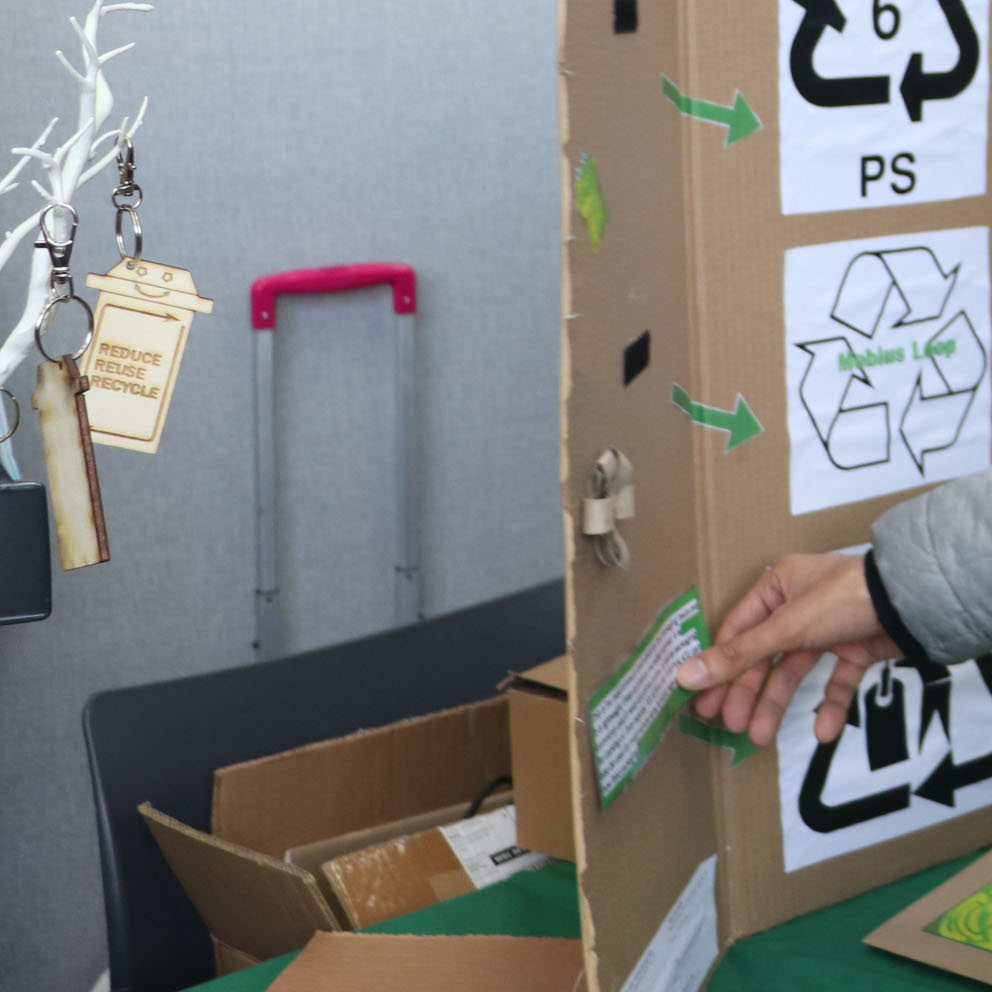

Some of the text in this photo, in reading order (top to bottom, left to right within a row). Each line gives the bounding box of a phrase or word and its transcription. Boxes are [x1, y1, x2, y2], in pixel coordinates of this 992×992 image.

[860, 152, 917, 198] PS
[98, 343, 162, 366] REDUCE
[911, 337, 957, 362] Loop
[95, 359, 147, 381] REUSE
[90, 375, 160, 399] RECYCLE
